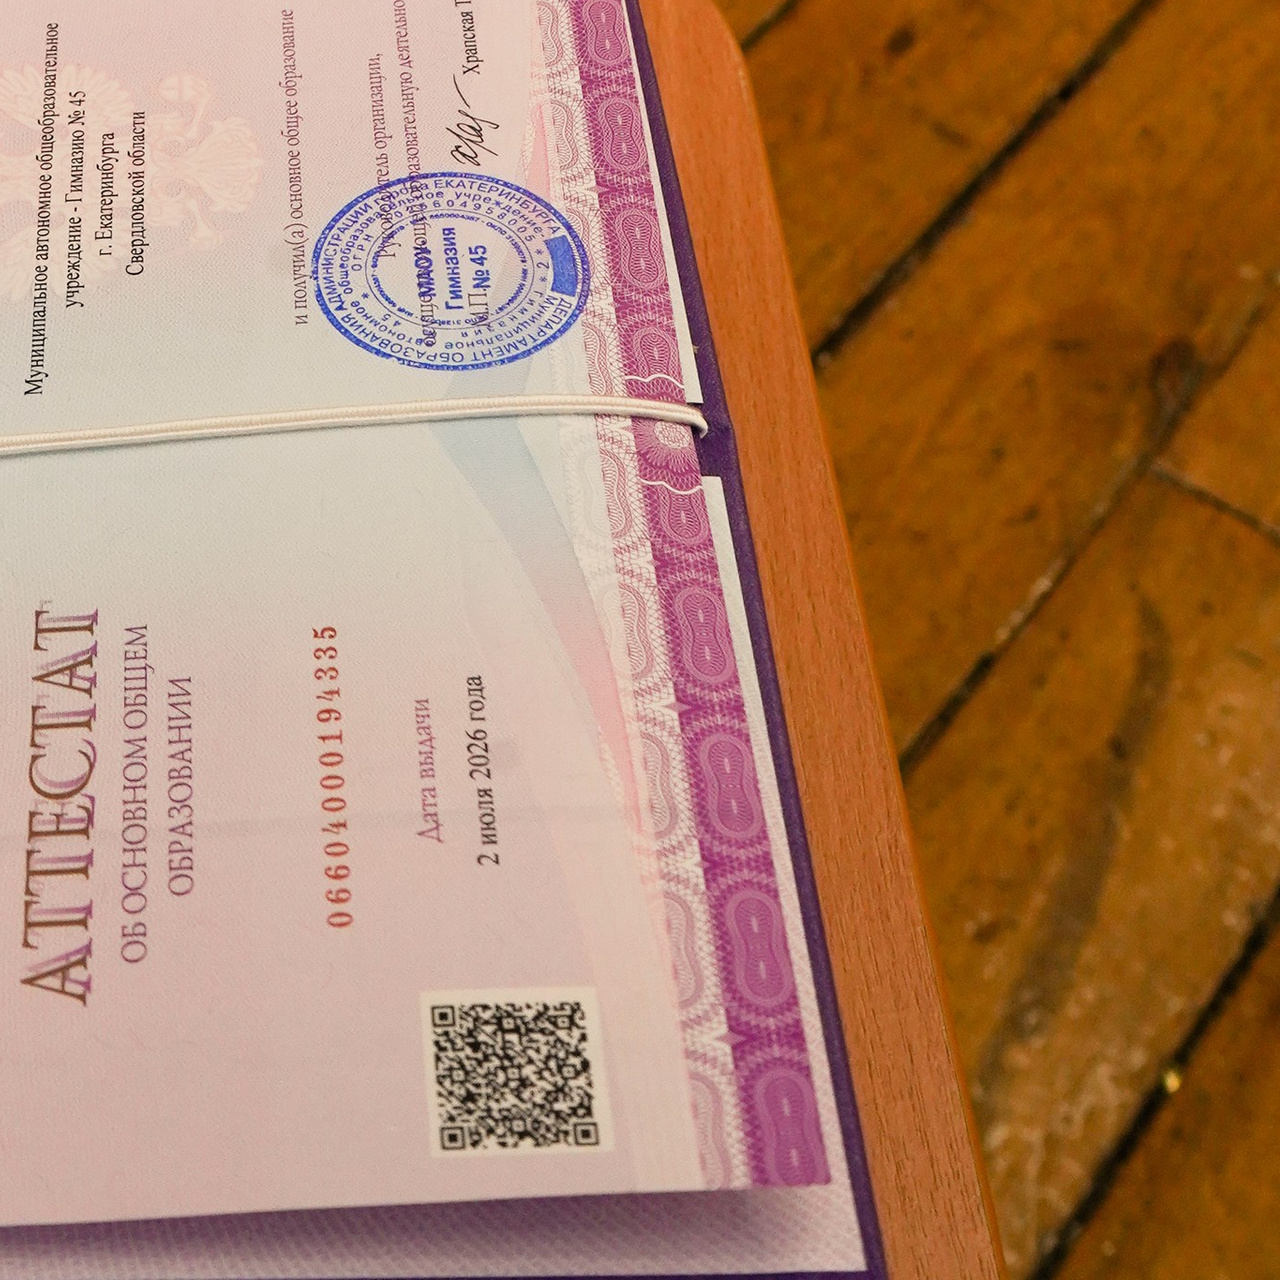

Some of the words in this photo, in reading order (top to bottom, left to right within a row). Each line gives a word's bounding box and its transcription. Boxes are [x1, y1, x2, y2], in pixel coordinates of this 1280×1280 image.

[280, 9, 305, 97] образование
[460, 11, 484, 75] Храпская
[36, 22, 60, 171] общеобразовательное
[67, 110, 85, 126] №
[69, 91, 86, 107] 45
[282, 100, 303, 146] общее
[365, 52, 395, 150] организации,
[65, 130, 85, 203] Гимназию
[127, 111, 146, 167] области
[32, 174, 52, 261] автономное
[94, 132, 119, 240] Екатеринбурга
[286, 150, 304, 219] основное
[434, 179, 562, 236] ЕКАТЕРИНБУРГА
[99, 245, 113, 256] г.
[125, 171, 149, 276] Свердловской
[321, 203, 373, 312] АДМИНИСТРАЦИИ
[469, 245, 487, 266] 45
[64, 217, 84, 308] учреждение
[283, 223, 317, 309] получил(а)
[442, 227, 464, 310] Гимназия
[472, 270, 491, 288] №
[24, 265, 49, 396] Муниципальное
[295, 314, 308, 325] и
[340, 312, 464, 363] ОБРАЗОВАНИЯ
[445, 295, 560, 349] Муниципальное
[471, 296, 573, 363] ДЕПАРТАМЕНТ
[122, 623, 155, 730] ОБЩЕМ
[464, 674, 491, 721] года
[411, 697, 440, 779] выдачи
[466, 728, 494, 780] 2026
[20, 599, 99, 1006] АТТЕСТАТ
[167, 675, 196, 897] ОБРАЗОВАНИИ
[312, 624, 354, 928] 06604000194335
[122, 735, 150, 914] ОСНОВНОМ
[416, 787, 444, 843] Дата
[474, 787, 500, 845] июля
[477, 851, 500, 867] 2
[121, 921, 149, 964] ОБ
